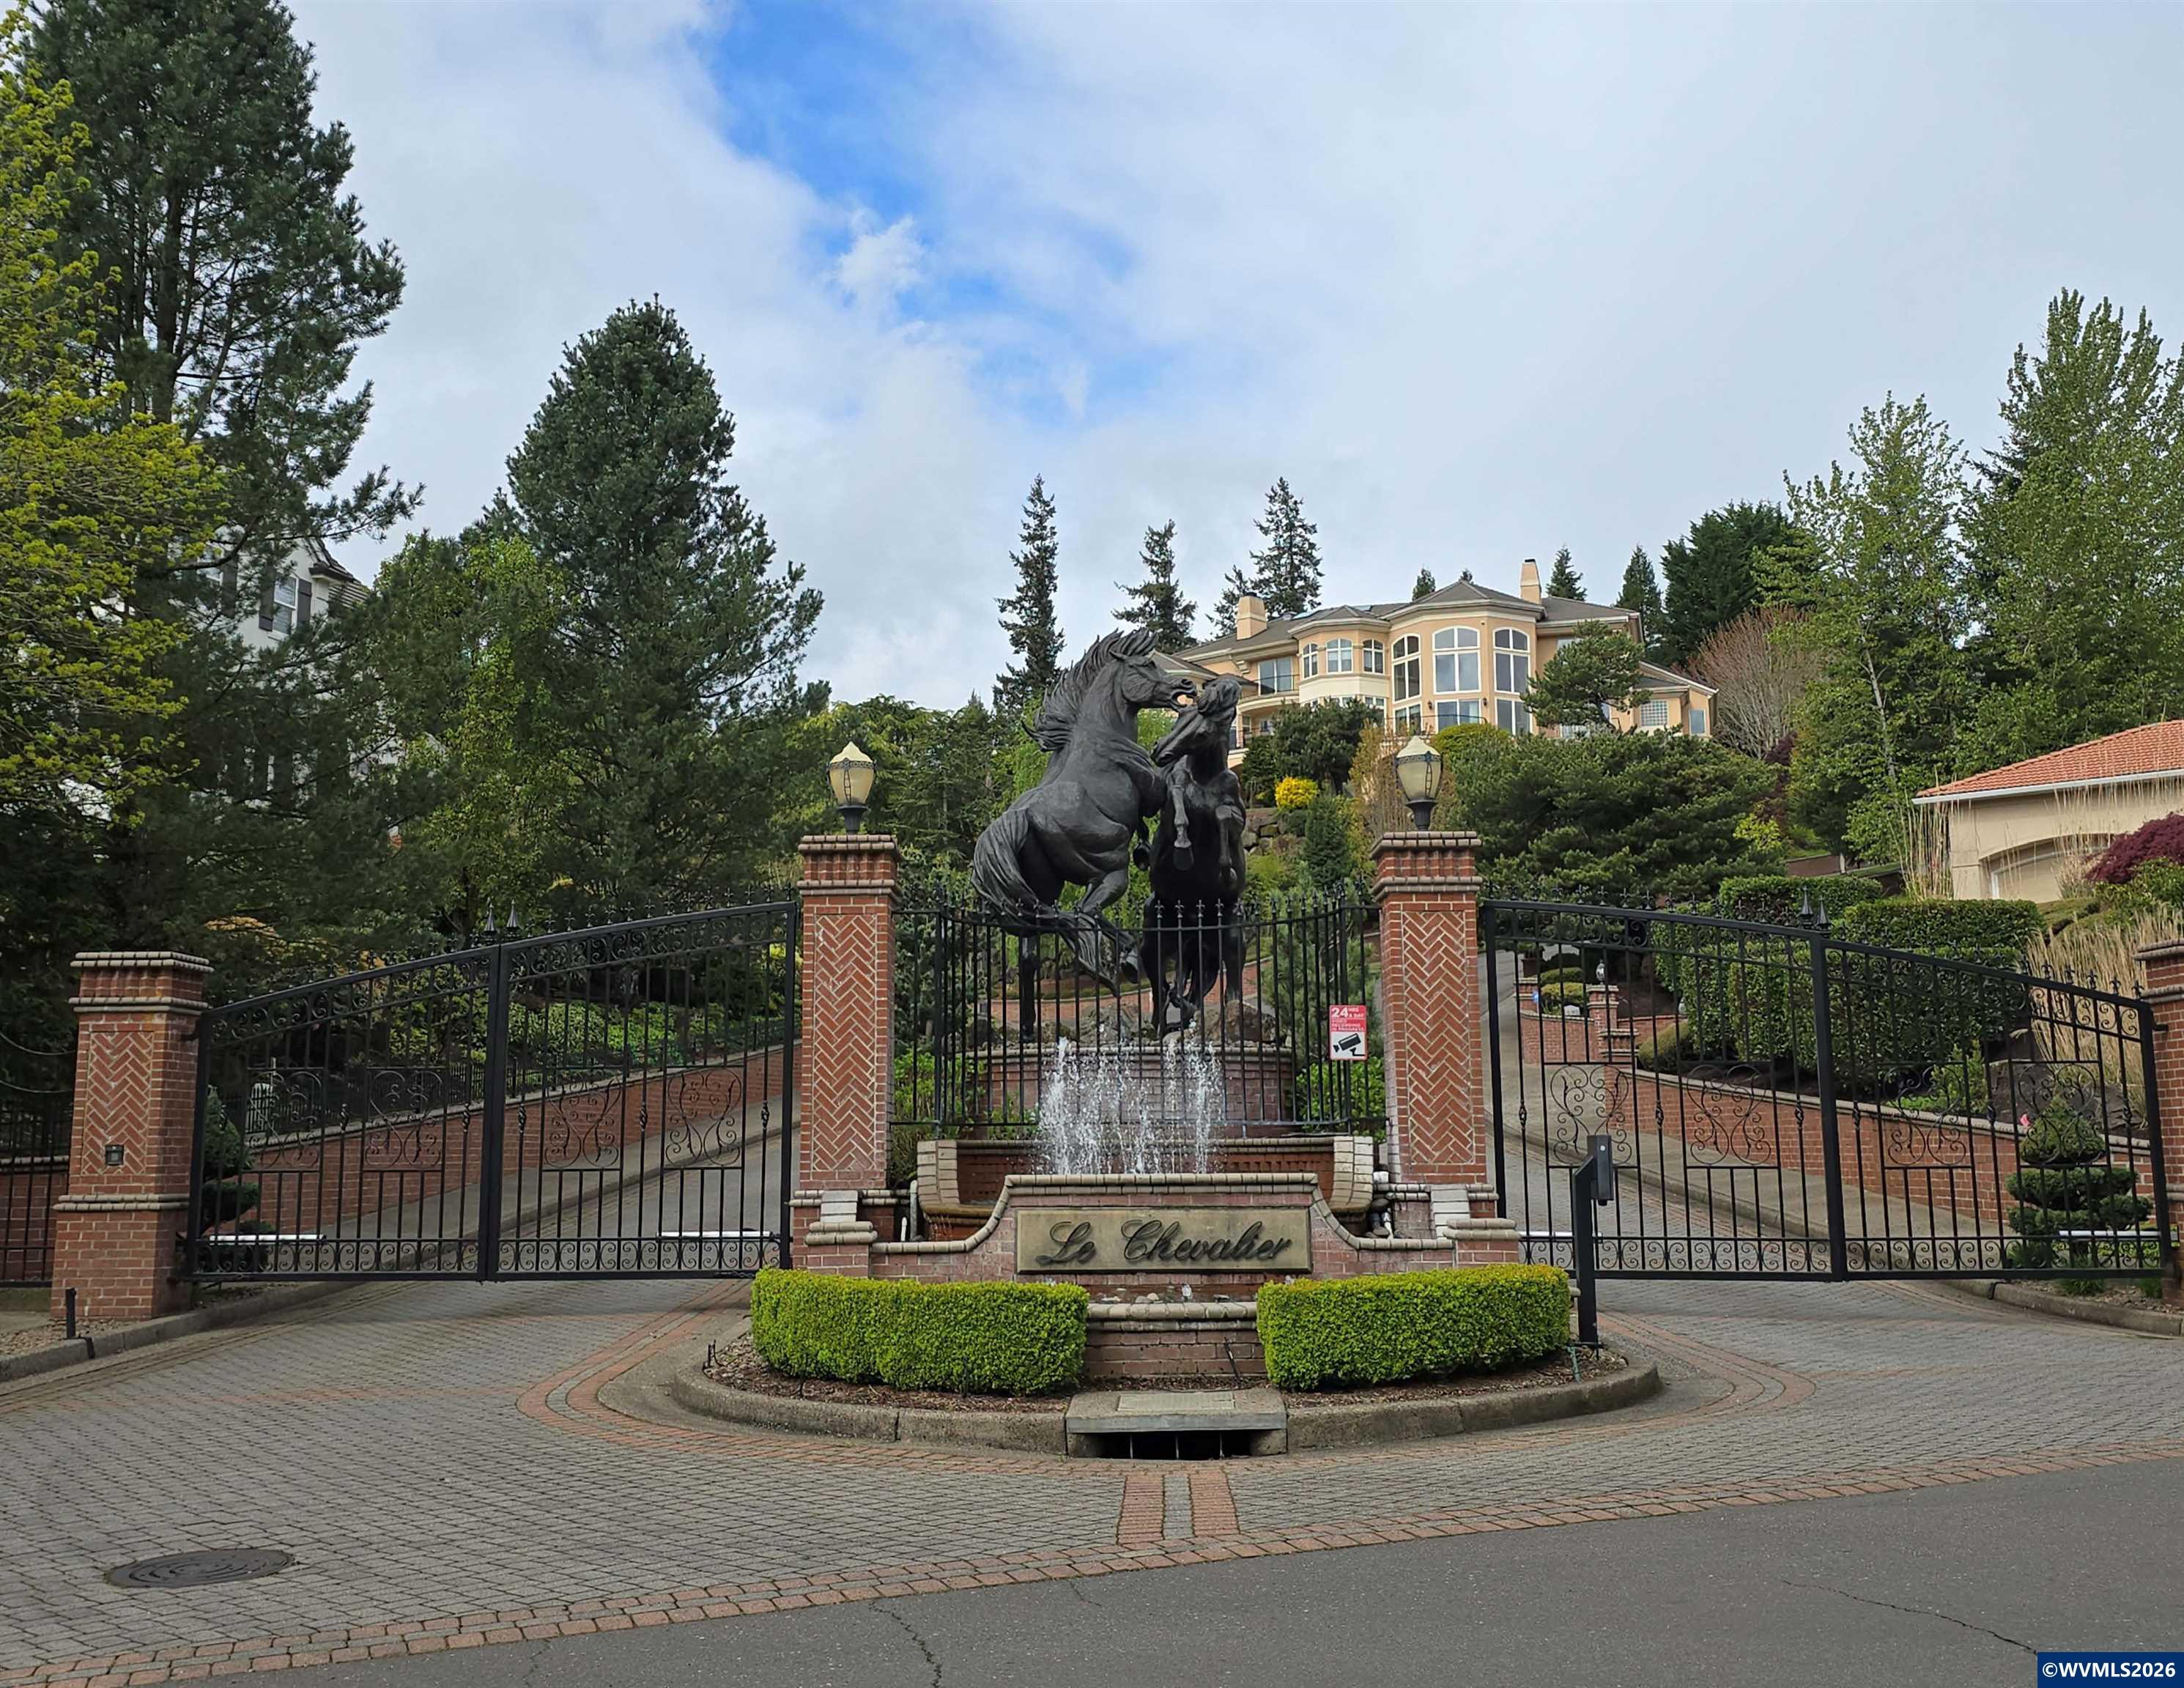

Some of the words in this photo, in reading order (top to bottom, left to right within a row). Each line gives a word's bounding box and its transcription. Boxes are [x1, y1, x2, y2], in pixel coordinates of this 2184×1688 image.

[1332, 1007, 1348, 1018] 24
[1036, 1221, 1096, 1265] Le
[1121, 1219, 1292, 1261] Chevalier
